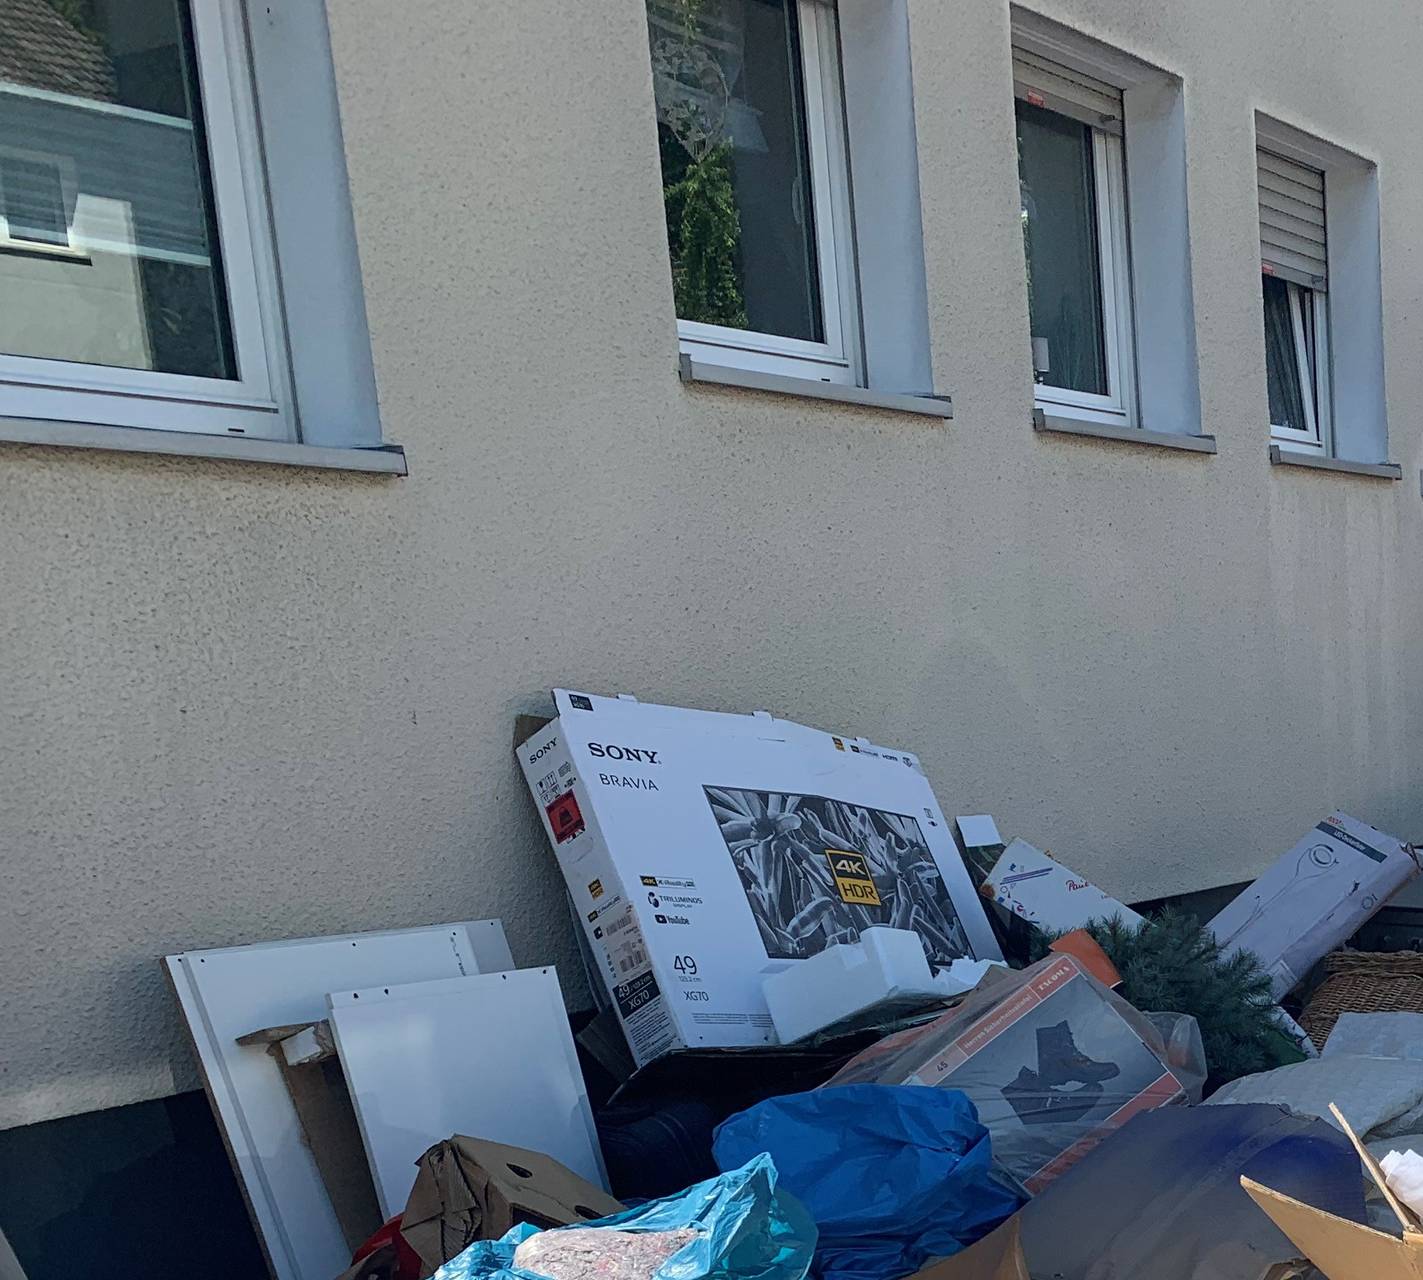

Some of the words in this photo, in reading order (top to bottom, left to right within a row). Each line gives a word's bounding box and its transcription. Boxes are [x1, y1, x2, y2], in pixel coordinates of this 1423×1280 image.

[529, 737, 557, 765] SONY
[587, 742, 658, 765] SONY
[599, 773, 660, 792] BRAVIA
[835, 859, 866, 876] 4K
[841, 882, 877, 900] HDR
[673, 955, 697, 975] 49
[1037, 965, 1071, 992] TACOMA
[619, 984, 630, 998] 49
[628, 989, 650, 1010] XG70
[683, 990, 710, 1002] XG70
[937, 1061, 948, 1072] 45
